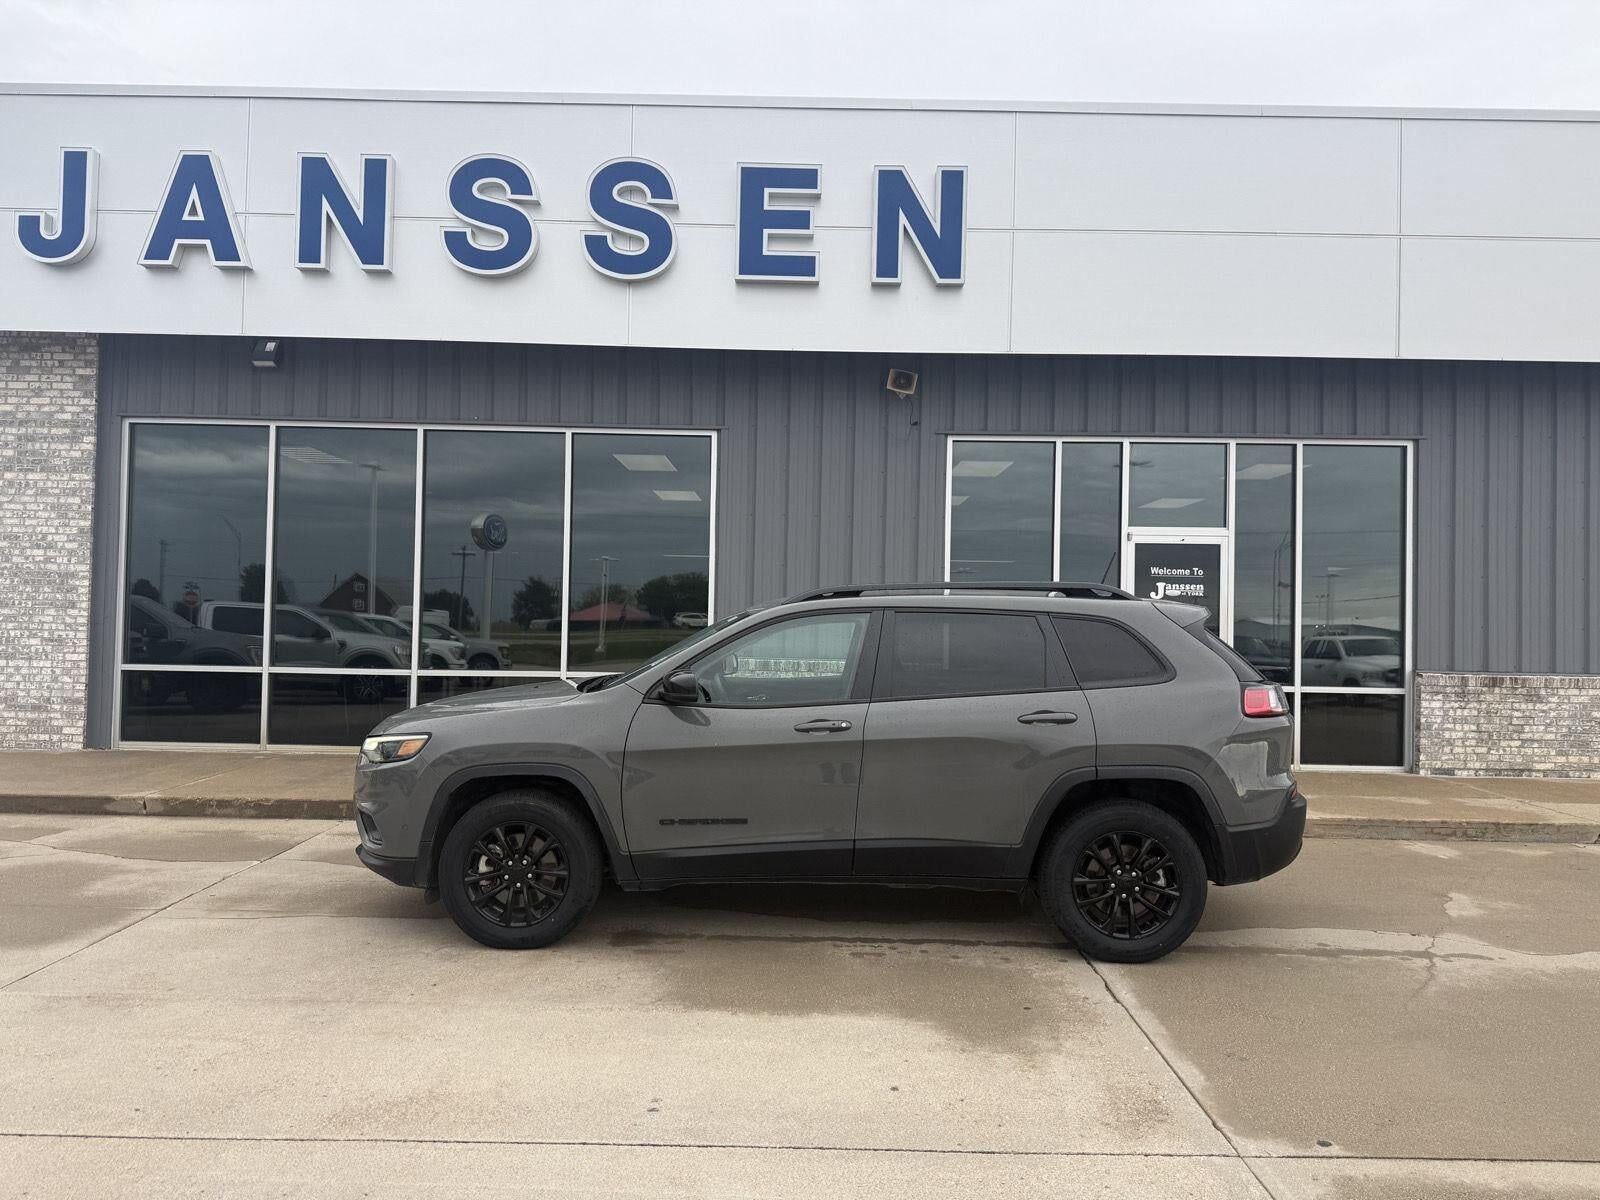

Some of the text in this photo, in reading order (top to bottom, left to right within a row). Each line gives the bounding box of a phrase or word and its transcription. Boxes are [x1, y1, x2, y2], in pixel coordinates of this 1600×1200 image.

[14, 146, 968, 287] JANSSEN
[1150, 566, 1204, 576] Welcome To
[1149, 581, 1204, 600] Janssen
